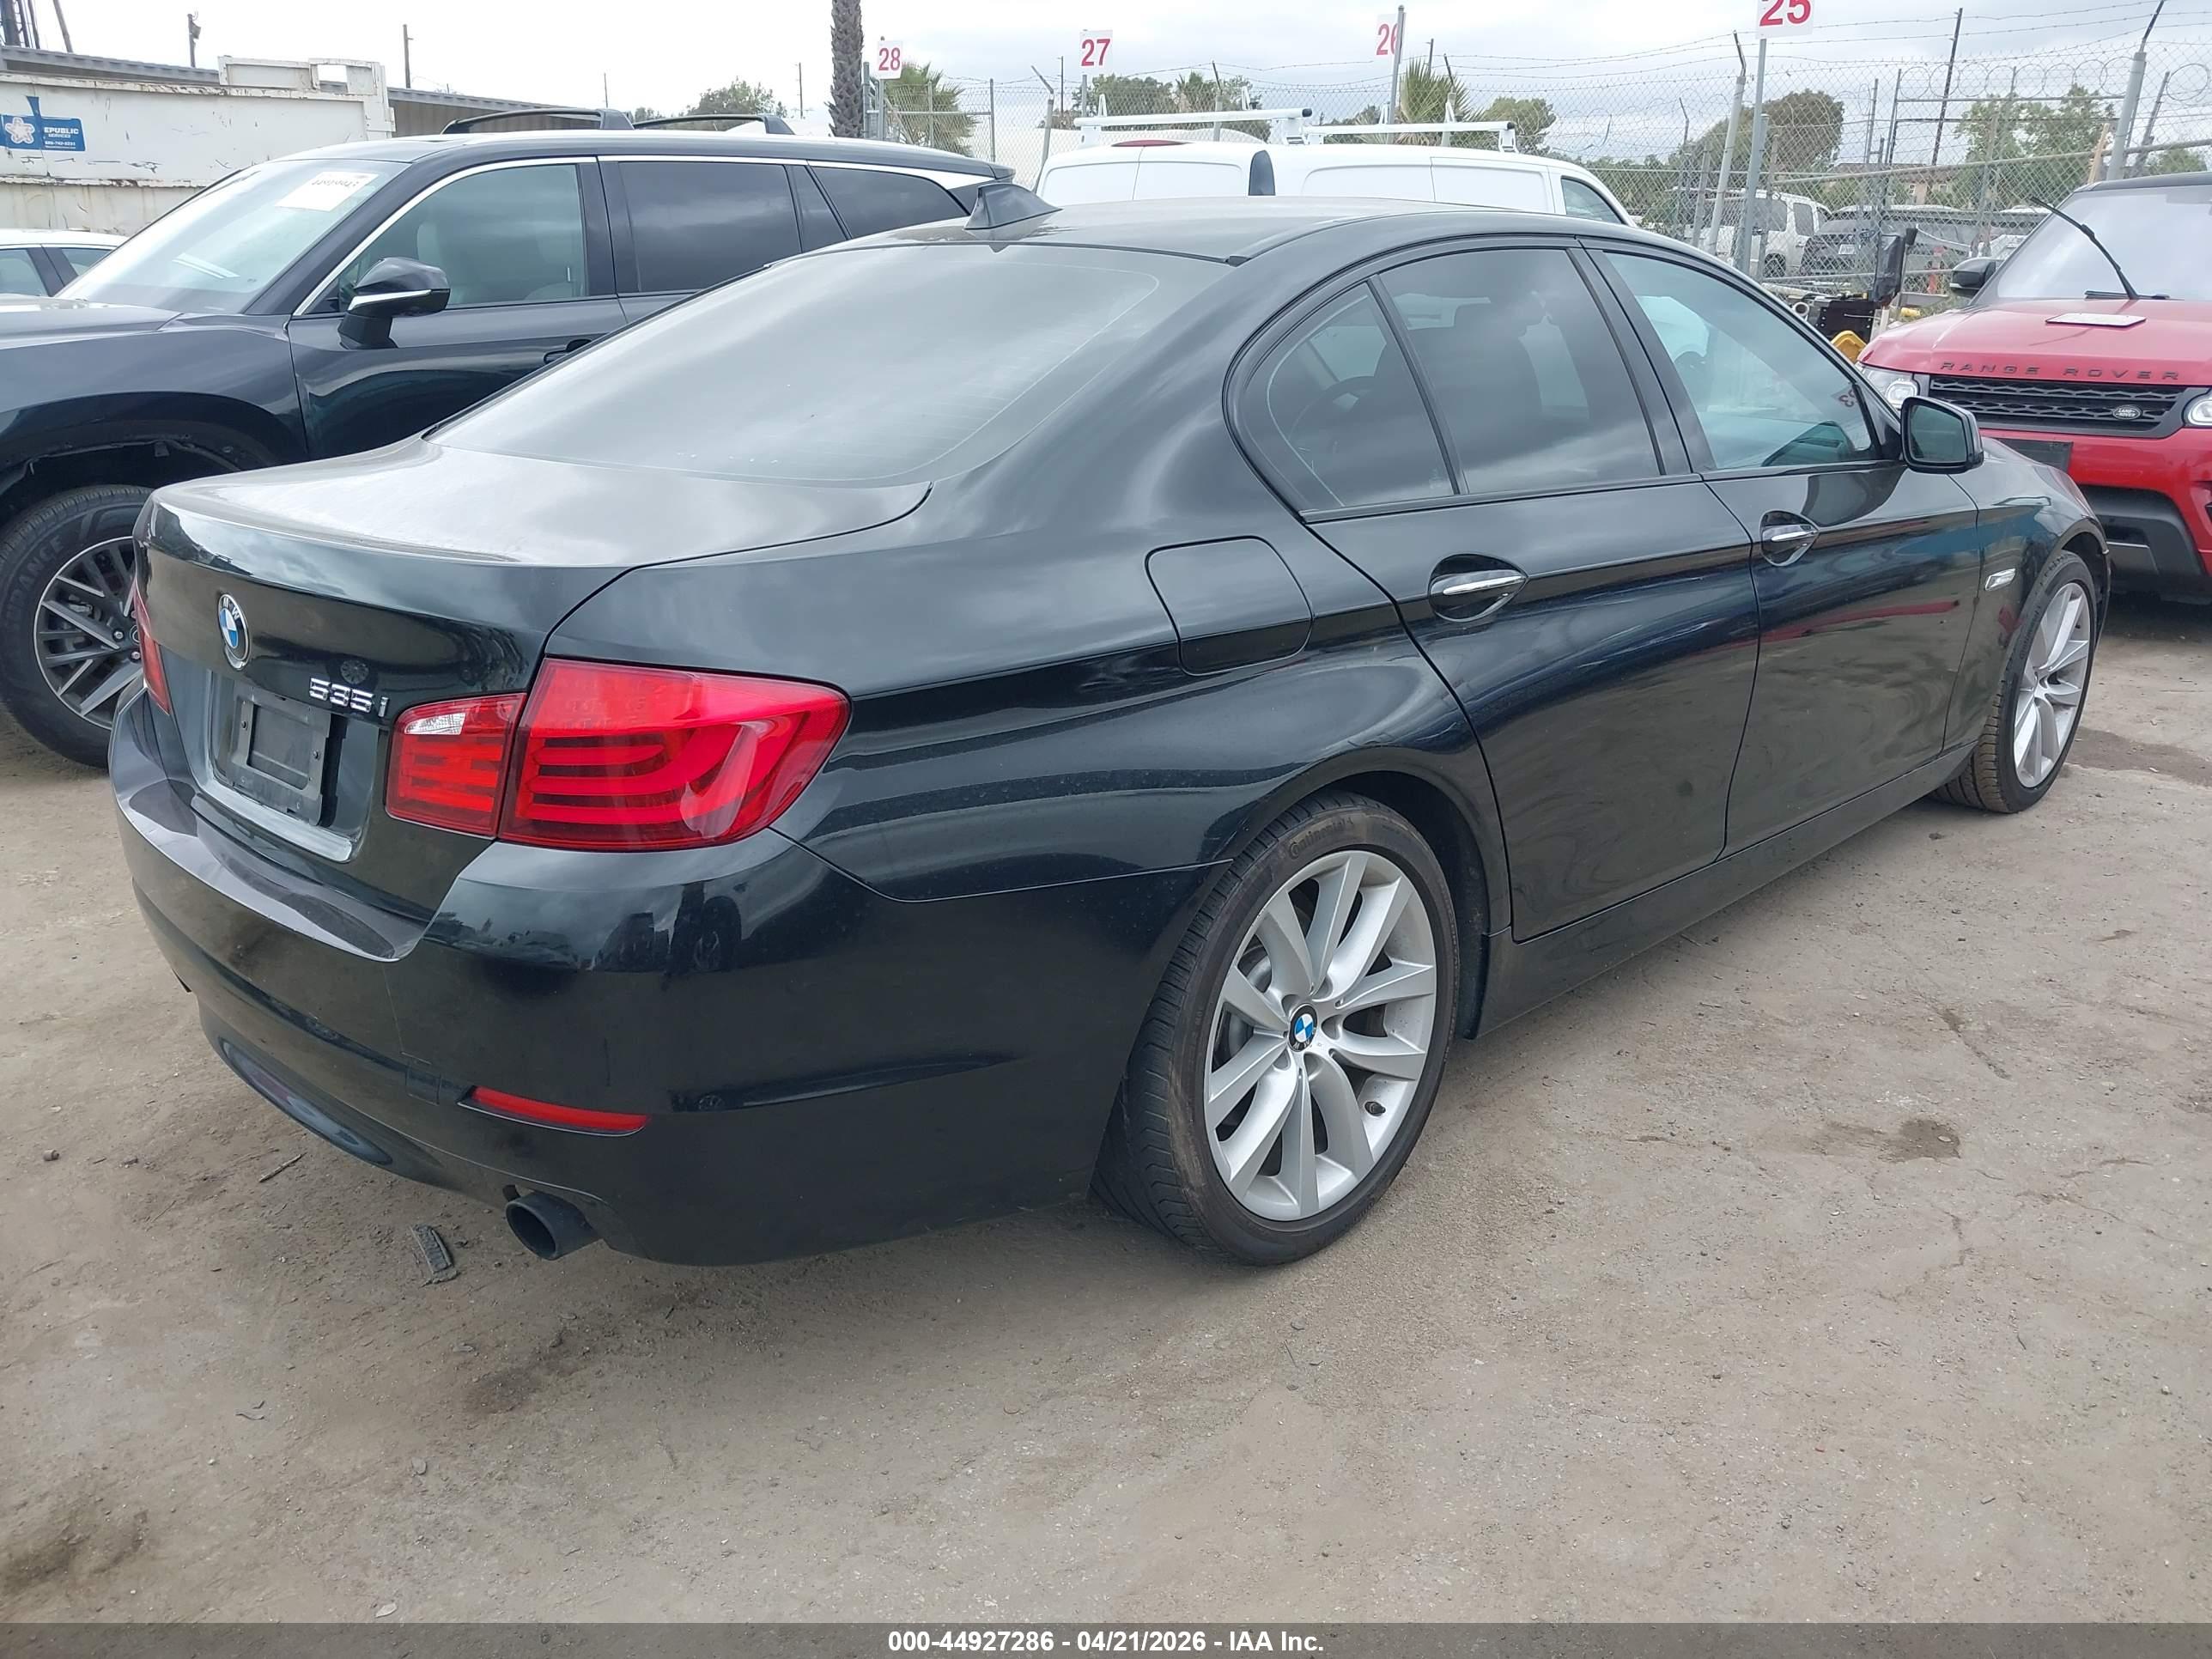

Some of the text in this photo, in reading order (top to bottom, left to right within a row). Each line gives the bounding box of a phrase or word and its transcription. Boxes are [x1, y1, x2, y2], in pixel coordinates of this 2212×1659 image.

[1759, 0, 1811, 27] 25
[878, 47, 901, 70] 28
[1081, 39, 1110, 66] 27
[1940, 362, 2040, 375] RANGE
[2063, 367, 2179, 380] ROVER
[309, 678, 389, 718] 535i
